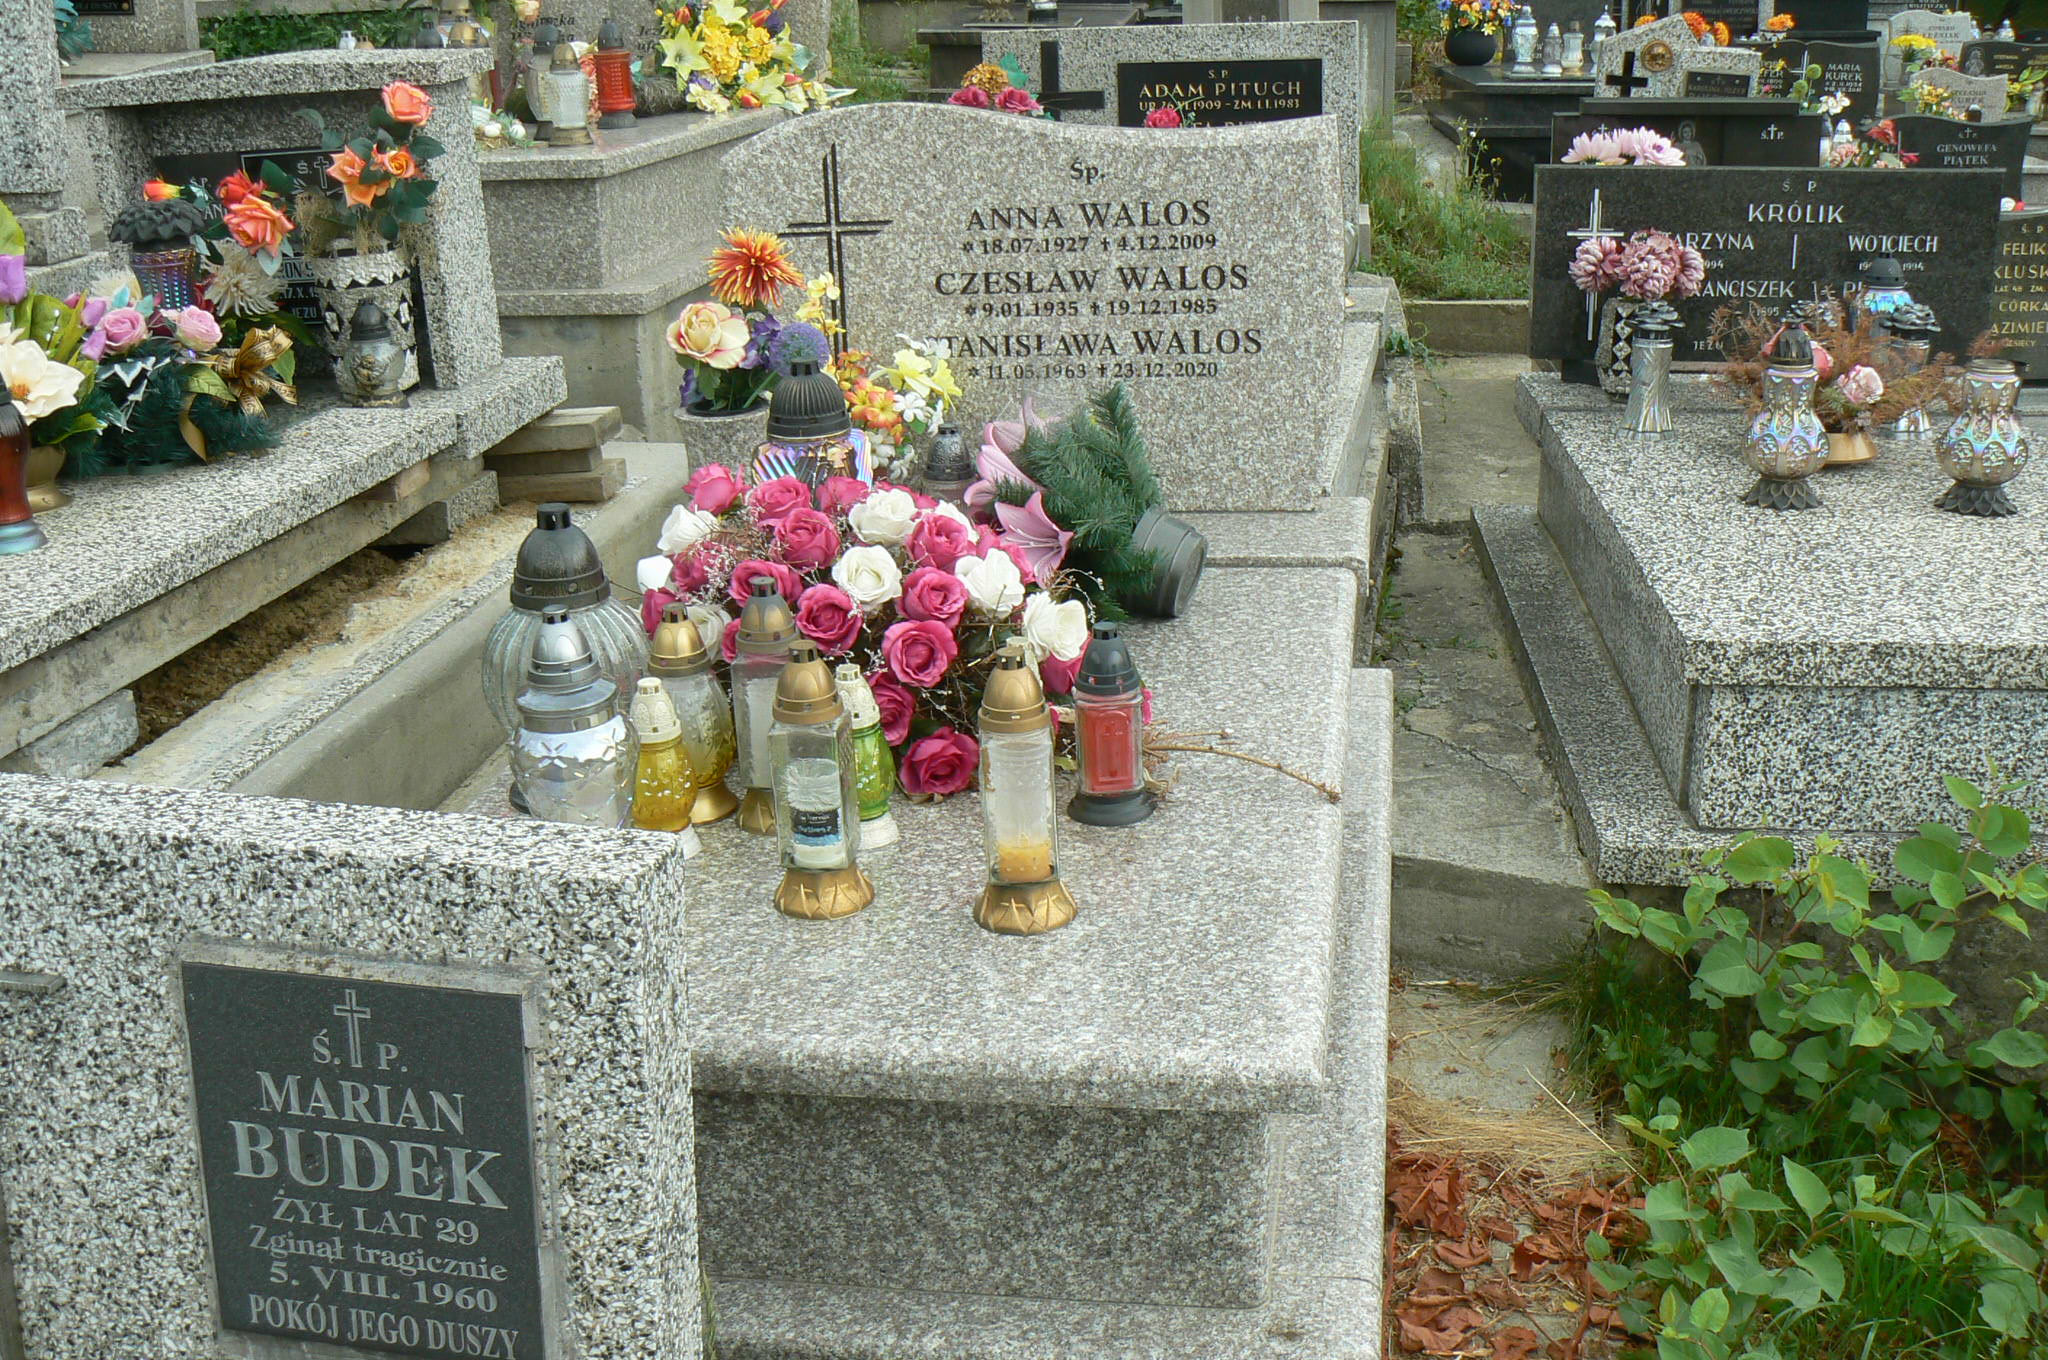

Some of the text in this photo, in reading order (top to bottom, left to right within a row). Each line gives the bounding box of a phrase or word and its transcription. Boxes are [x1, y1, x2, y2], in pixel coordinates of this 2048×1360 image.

[1824, 72, 1863, 81] KUREK
[1827, 63, 1861, 72] MARIA
[1139, 81, 1300, 98] ADAM PITUCH
[1936, 144, 1997, 152] GENOWEFA
[1943, 155, 1989, 167] PIĄTEK
[966, 200, 1211, 231] ANNA WALOS
[1748, 200, 1844, 223] KRÓLIK
[979, 233, 1217, 254] 18.07.1927 4.12.2009
[1663, 232, 1938, 252] ARZYNA WOJCIECH
[2003, 243, 2048, 256] FELIK
[935, 264, 1248, 295] CZESŁAW WALOS
[982, 298, 1217, 318] 9.01.1935 19.12.1985
[1990, 321, 2048, 334] AZIMIE
[925, 328, 1262, 358] TANISŁAWA WALOS
[987, 362, 1218, 380] 11.05.1963 23.12.2020
[256, 1071, 465, 1135] MARIAN
[229, 1121, 508, 1210] BUDEK
[272, 1185, 479, 1246] ŻYŁ LAT 29
[249, 1225, 508, 1282] Zginął tragicznie
[270, 1261, 498, 1313] 5. VIII. 1960
[249, 1293, 519, 1360] POKÓJ JEGO DUSZY
